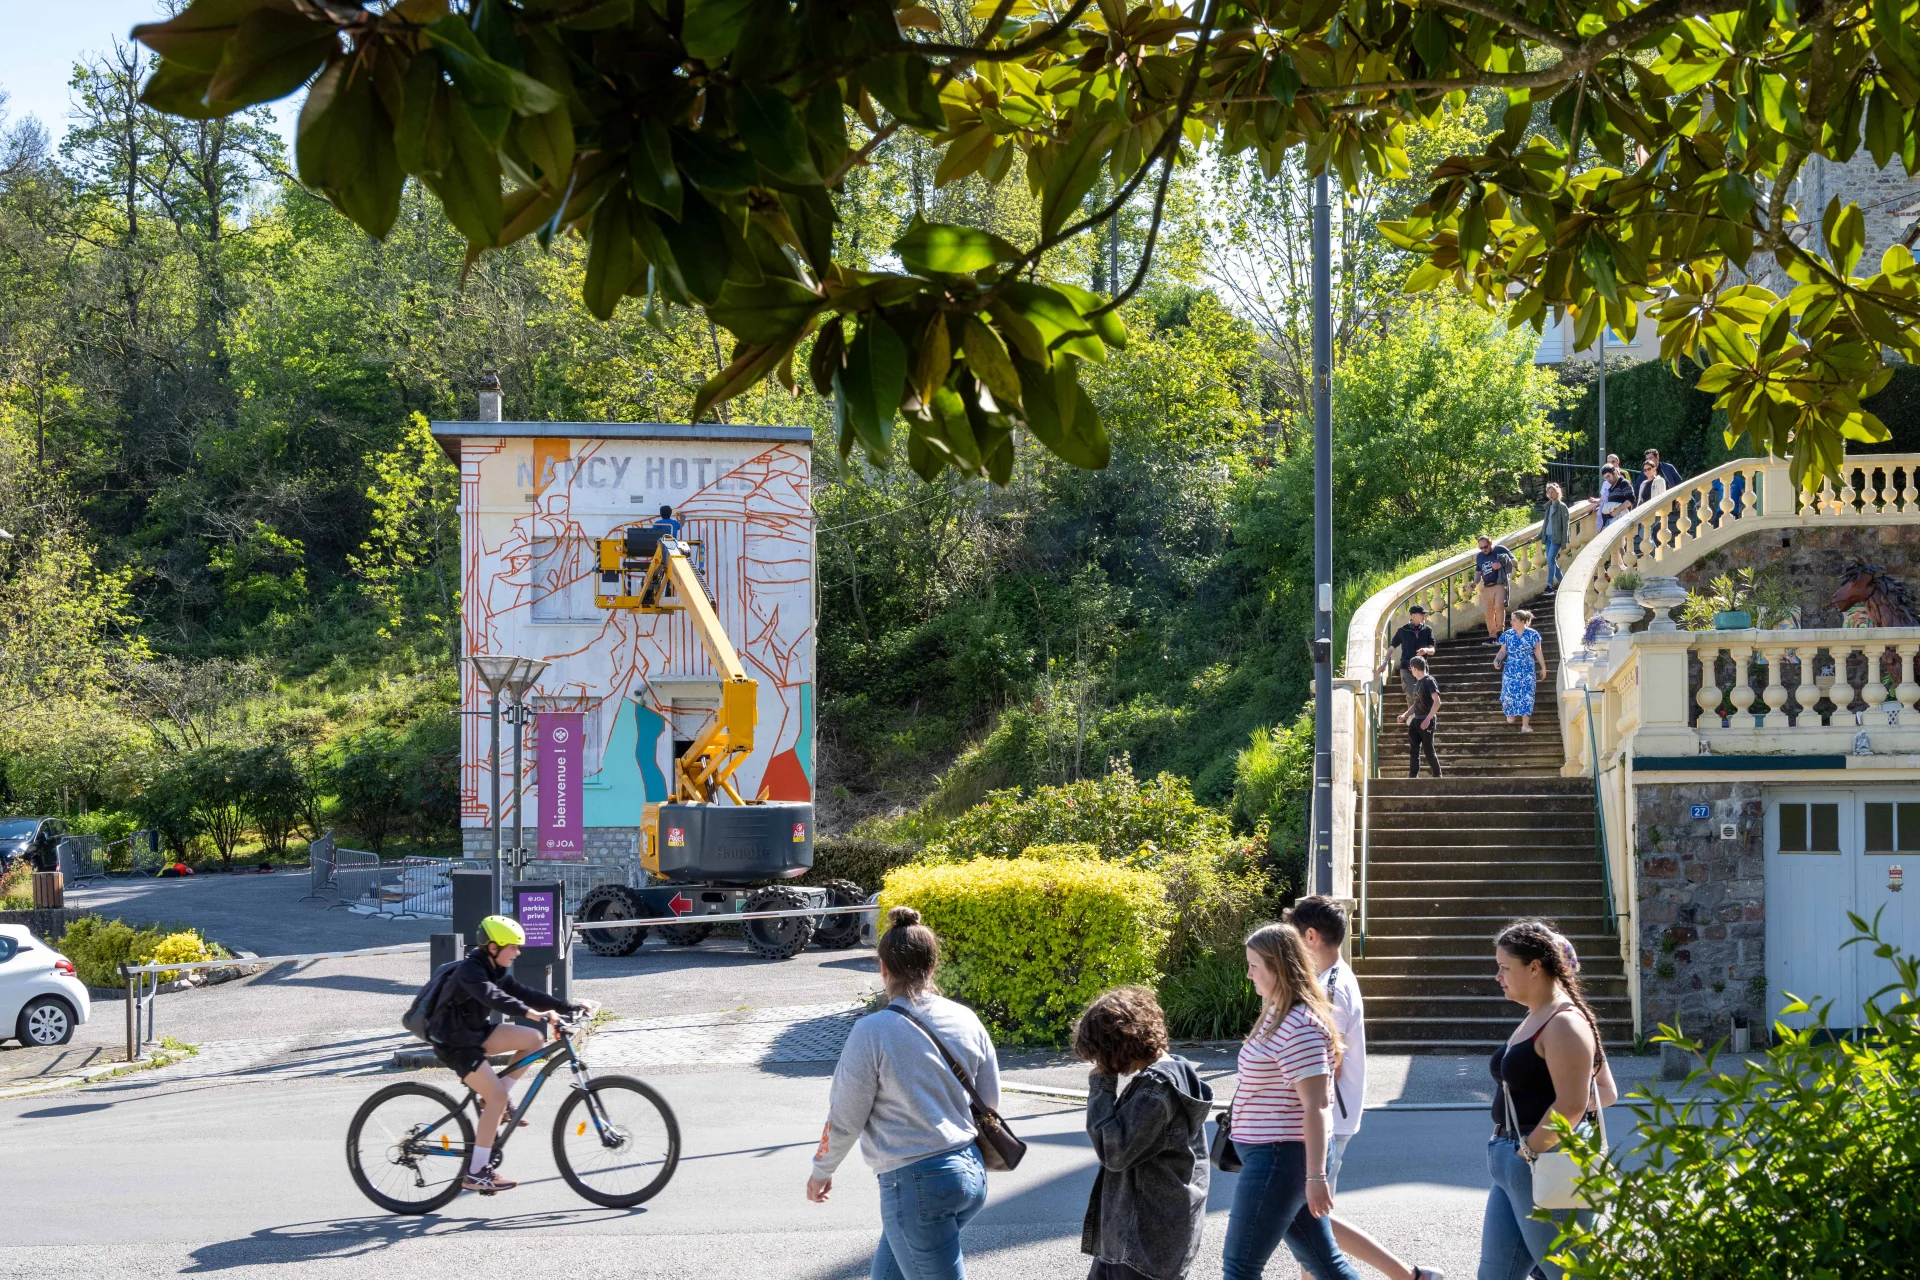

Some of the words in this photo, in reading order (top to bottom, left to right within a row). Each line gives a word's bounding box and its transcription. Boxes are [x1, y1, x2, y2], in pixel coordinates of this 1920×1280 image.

[517, 455, 632, 490] NANCY
[645, 457, 757, 491] HOTEL
[552, 757, 566, 828] bienvenue
[1695, 808, 1706, 816] 27
[556, 840, 574, 848] JOA
[527, 912, 546, 920] privé
